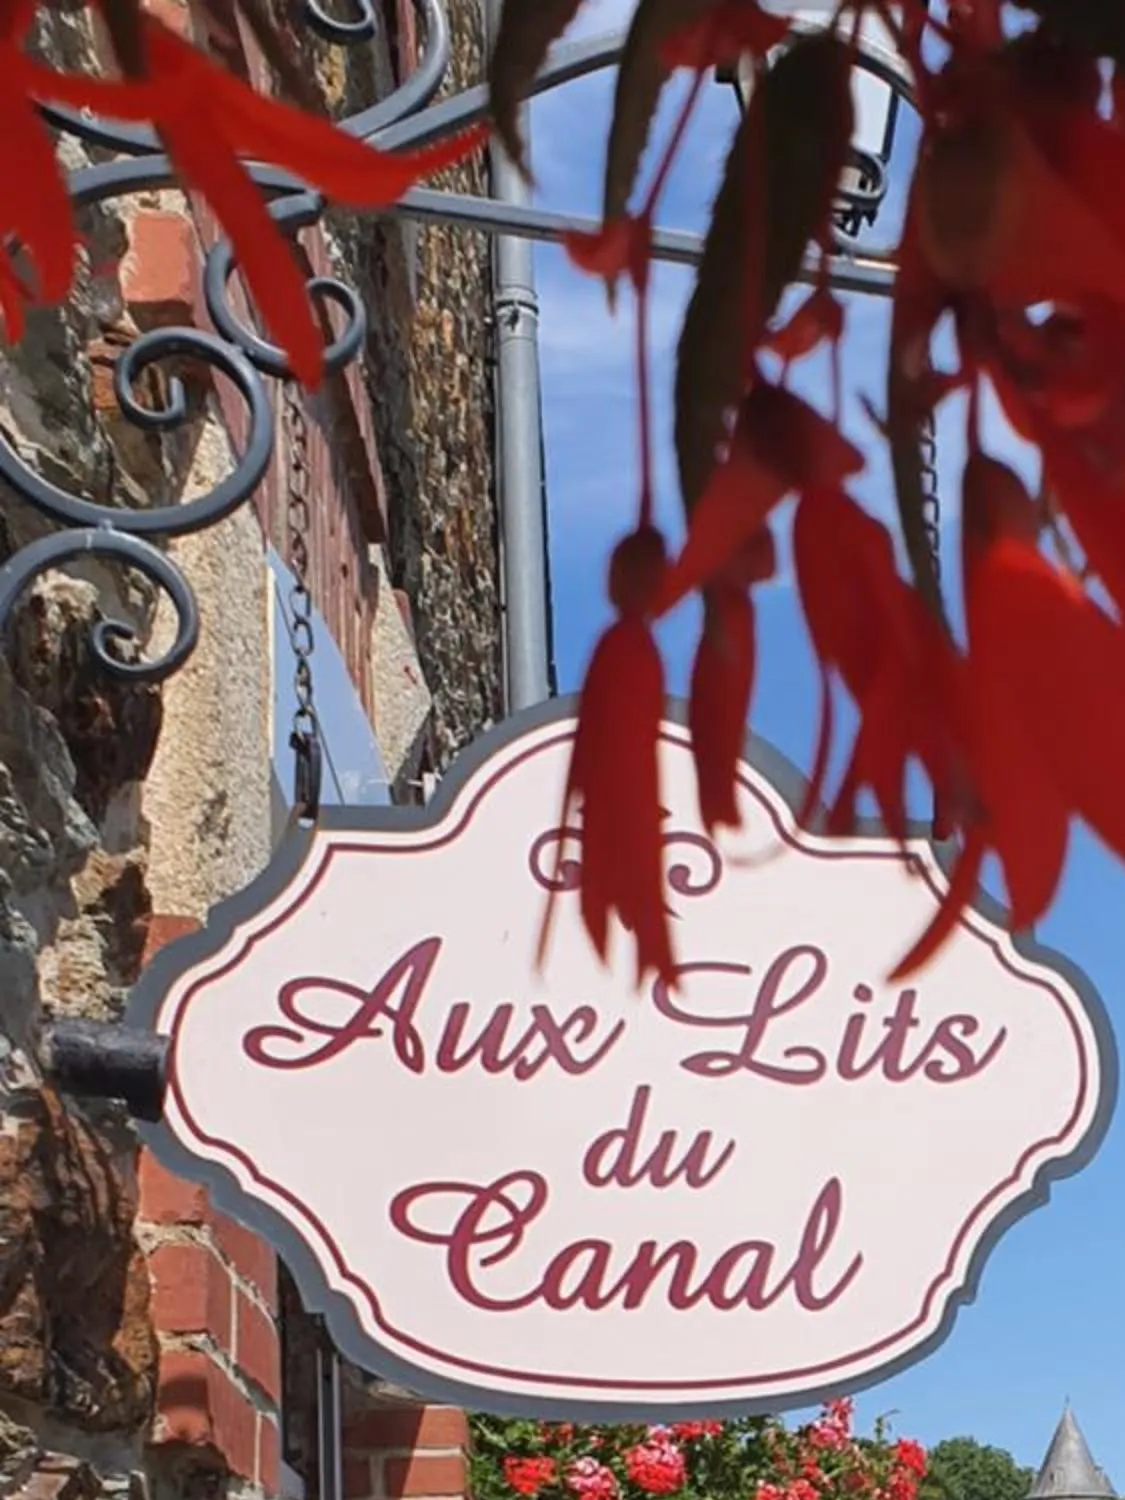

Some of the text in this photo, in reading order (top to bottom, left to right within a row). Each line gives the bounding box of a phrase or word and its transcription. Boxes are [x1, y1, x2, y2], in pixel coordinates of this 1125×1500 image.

[243, 937, 1007, 1086] Aux Lits
[583, 1085, 735, 1188] du
[390, 1170, 863, 1312] Canal
